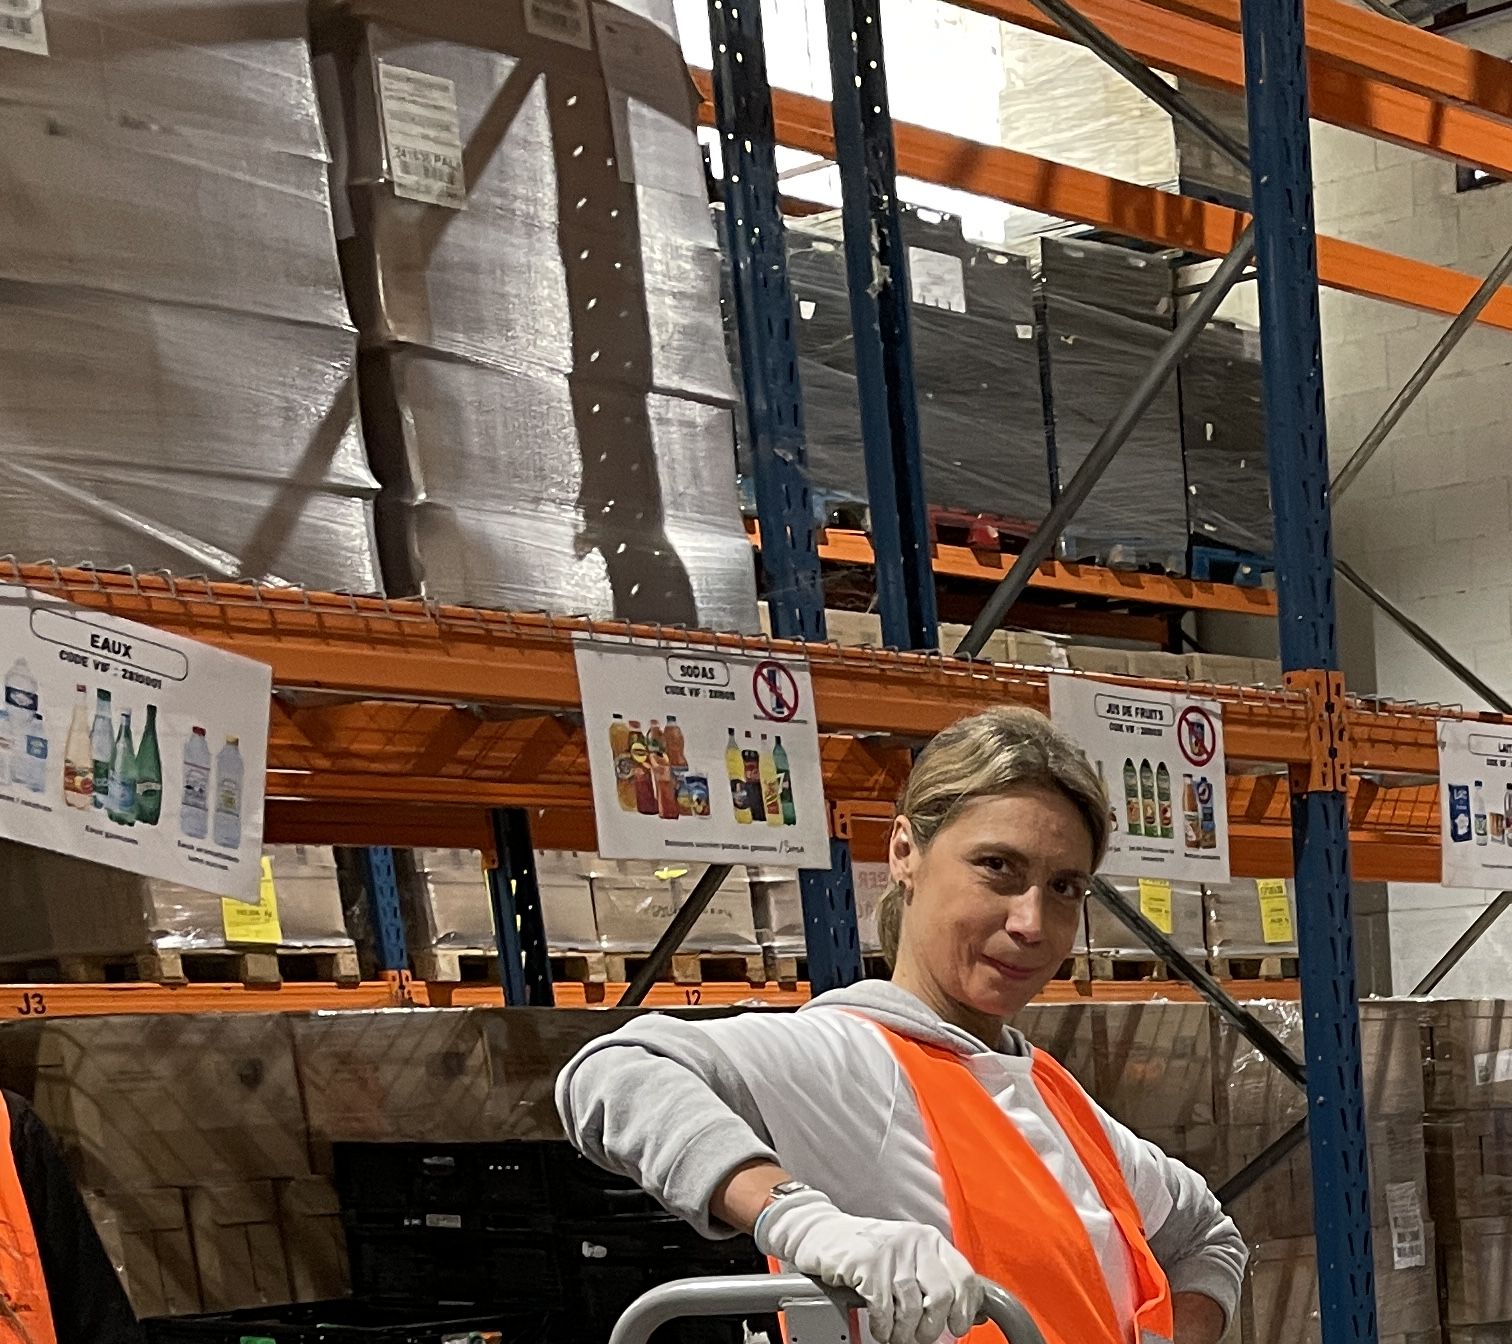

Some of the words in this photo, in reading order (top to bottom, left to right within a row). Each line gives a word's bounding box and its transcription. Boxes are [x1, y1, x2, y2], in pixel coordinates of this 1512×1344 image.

[90, 634, 133, 660] EAUX
[59, 650, 89, 668] CODE
[680, 664, 715, 680] SODAS
[1106, 703, 1120, 716] JUS
[1122, 704, 1133, 718] DE
[1134, 706, 1164, 721] FRUITS
[16, 992, 47, 1016] J3
